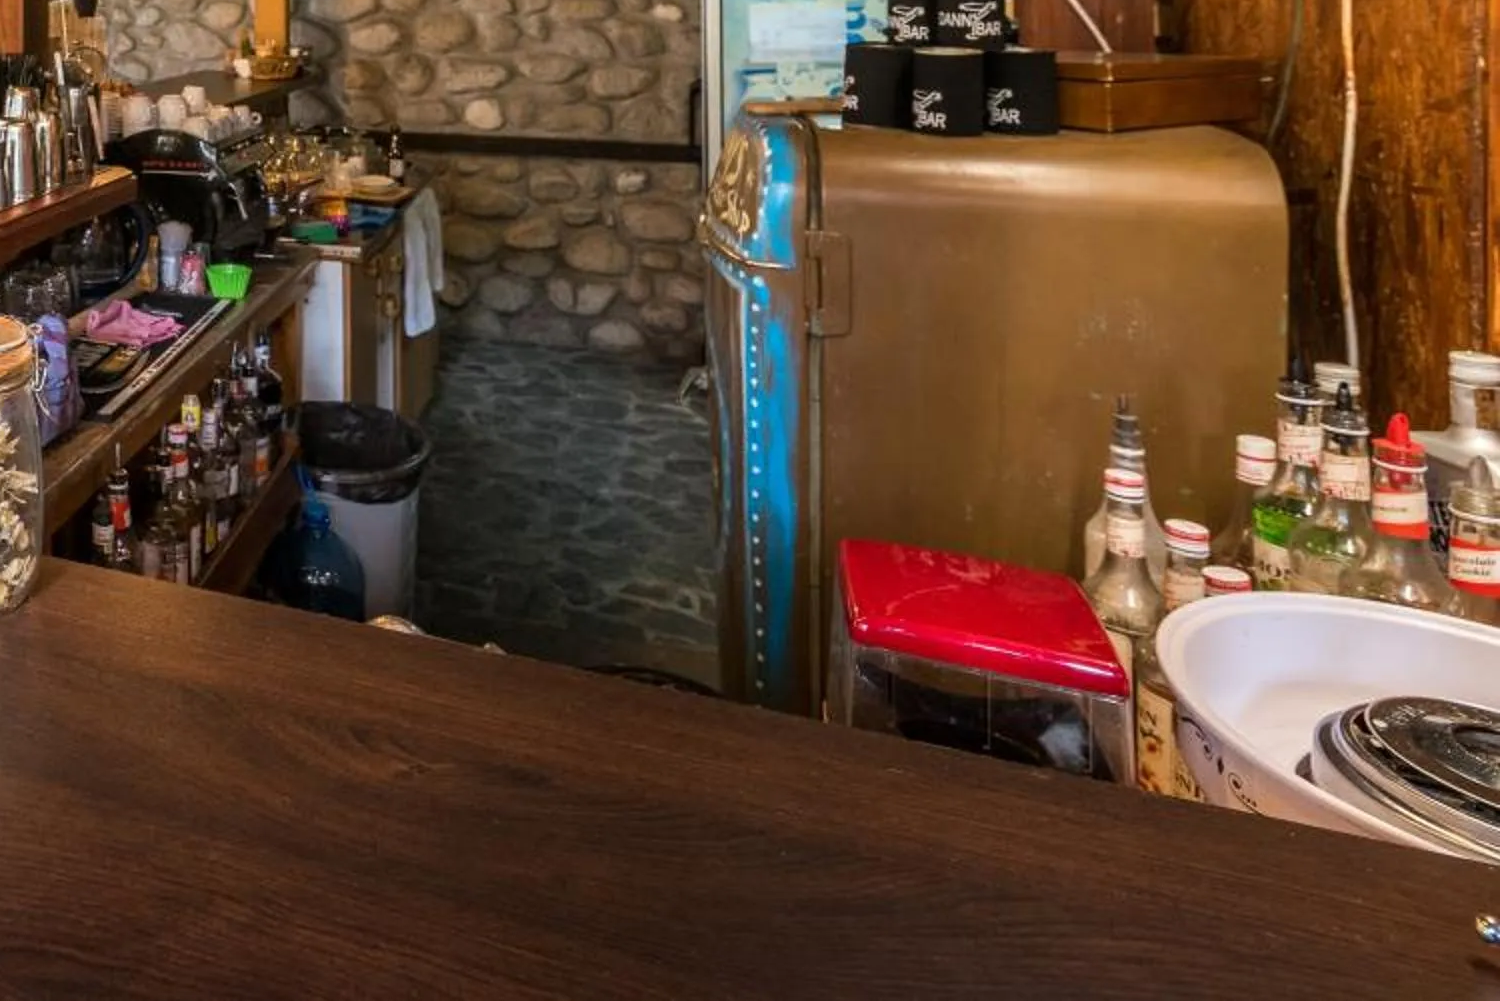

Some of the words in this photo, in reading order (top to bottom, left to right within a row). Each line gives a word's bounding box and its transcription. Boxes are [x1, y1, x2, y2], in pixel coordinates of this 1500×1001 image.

[902, 24, 930, 40] BAR
[976, 21, 1002, 37] BAR
[918, 111, 947, 130] BAR
